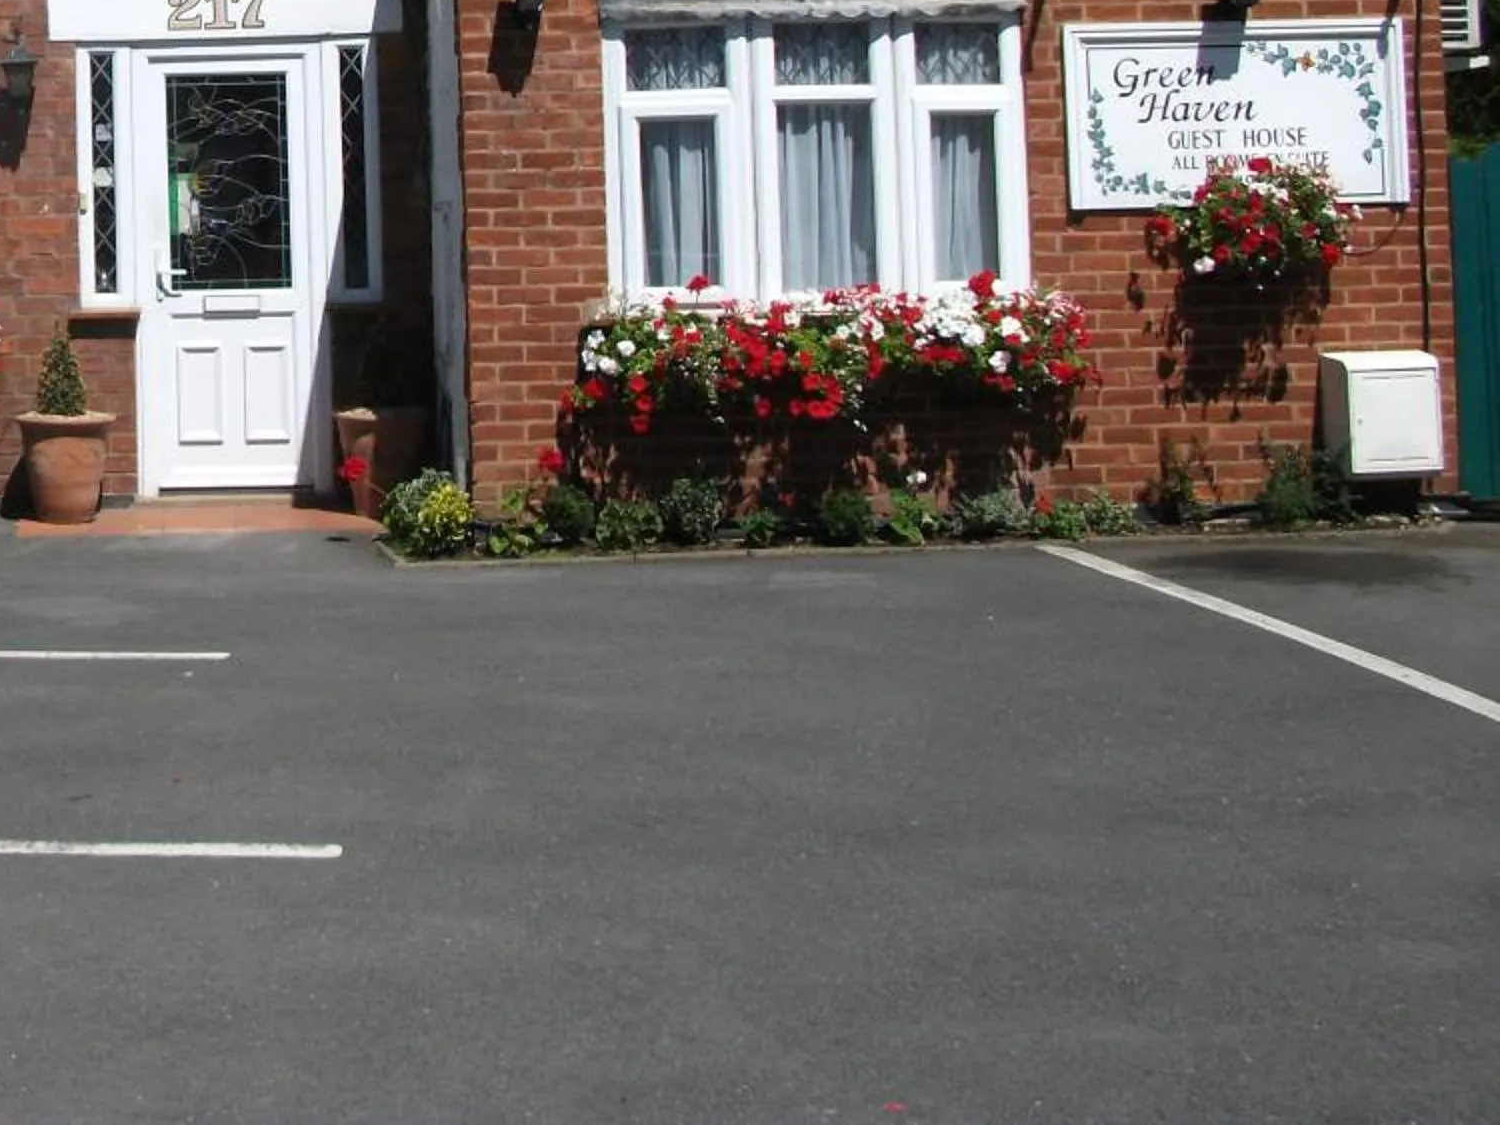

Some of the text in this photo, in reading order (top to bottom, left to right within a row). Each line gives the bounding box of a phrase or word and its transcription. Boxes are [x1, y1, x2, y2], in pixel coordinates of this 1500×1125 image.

[1113, 58, 1215, 97] Green
[1137, 90, 1258, 123] Haven
[1167, 126, 1308, 150] GUEST HOUSE
[1172, 154, 1200, 170] ALL
[1205, 153, 1257, 170] ROOM
